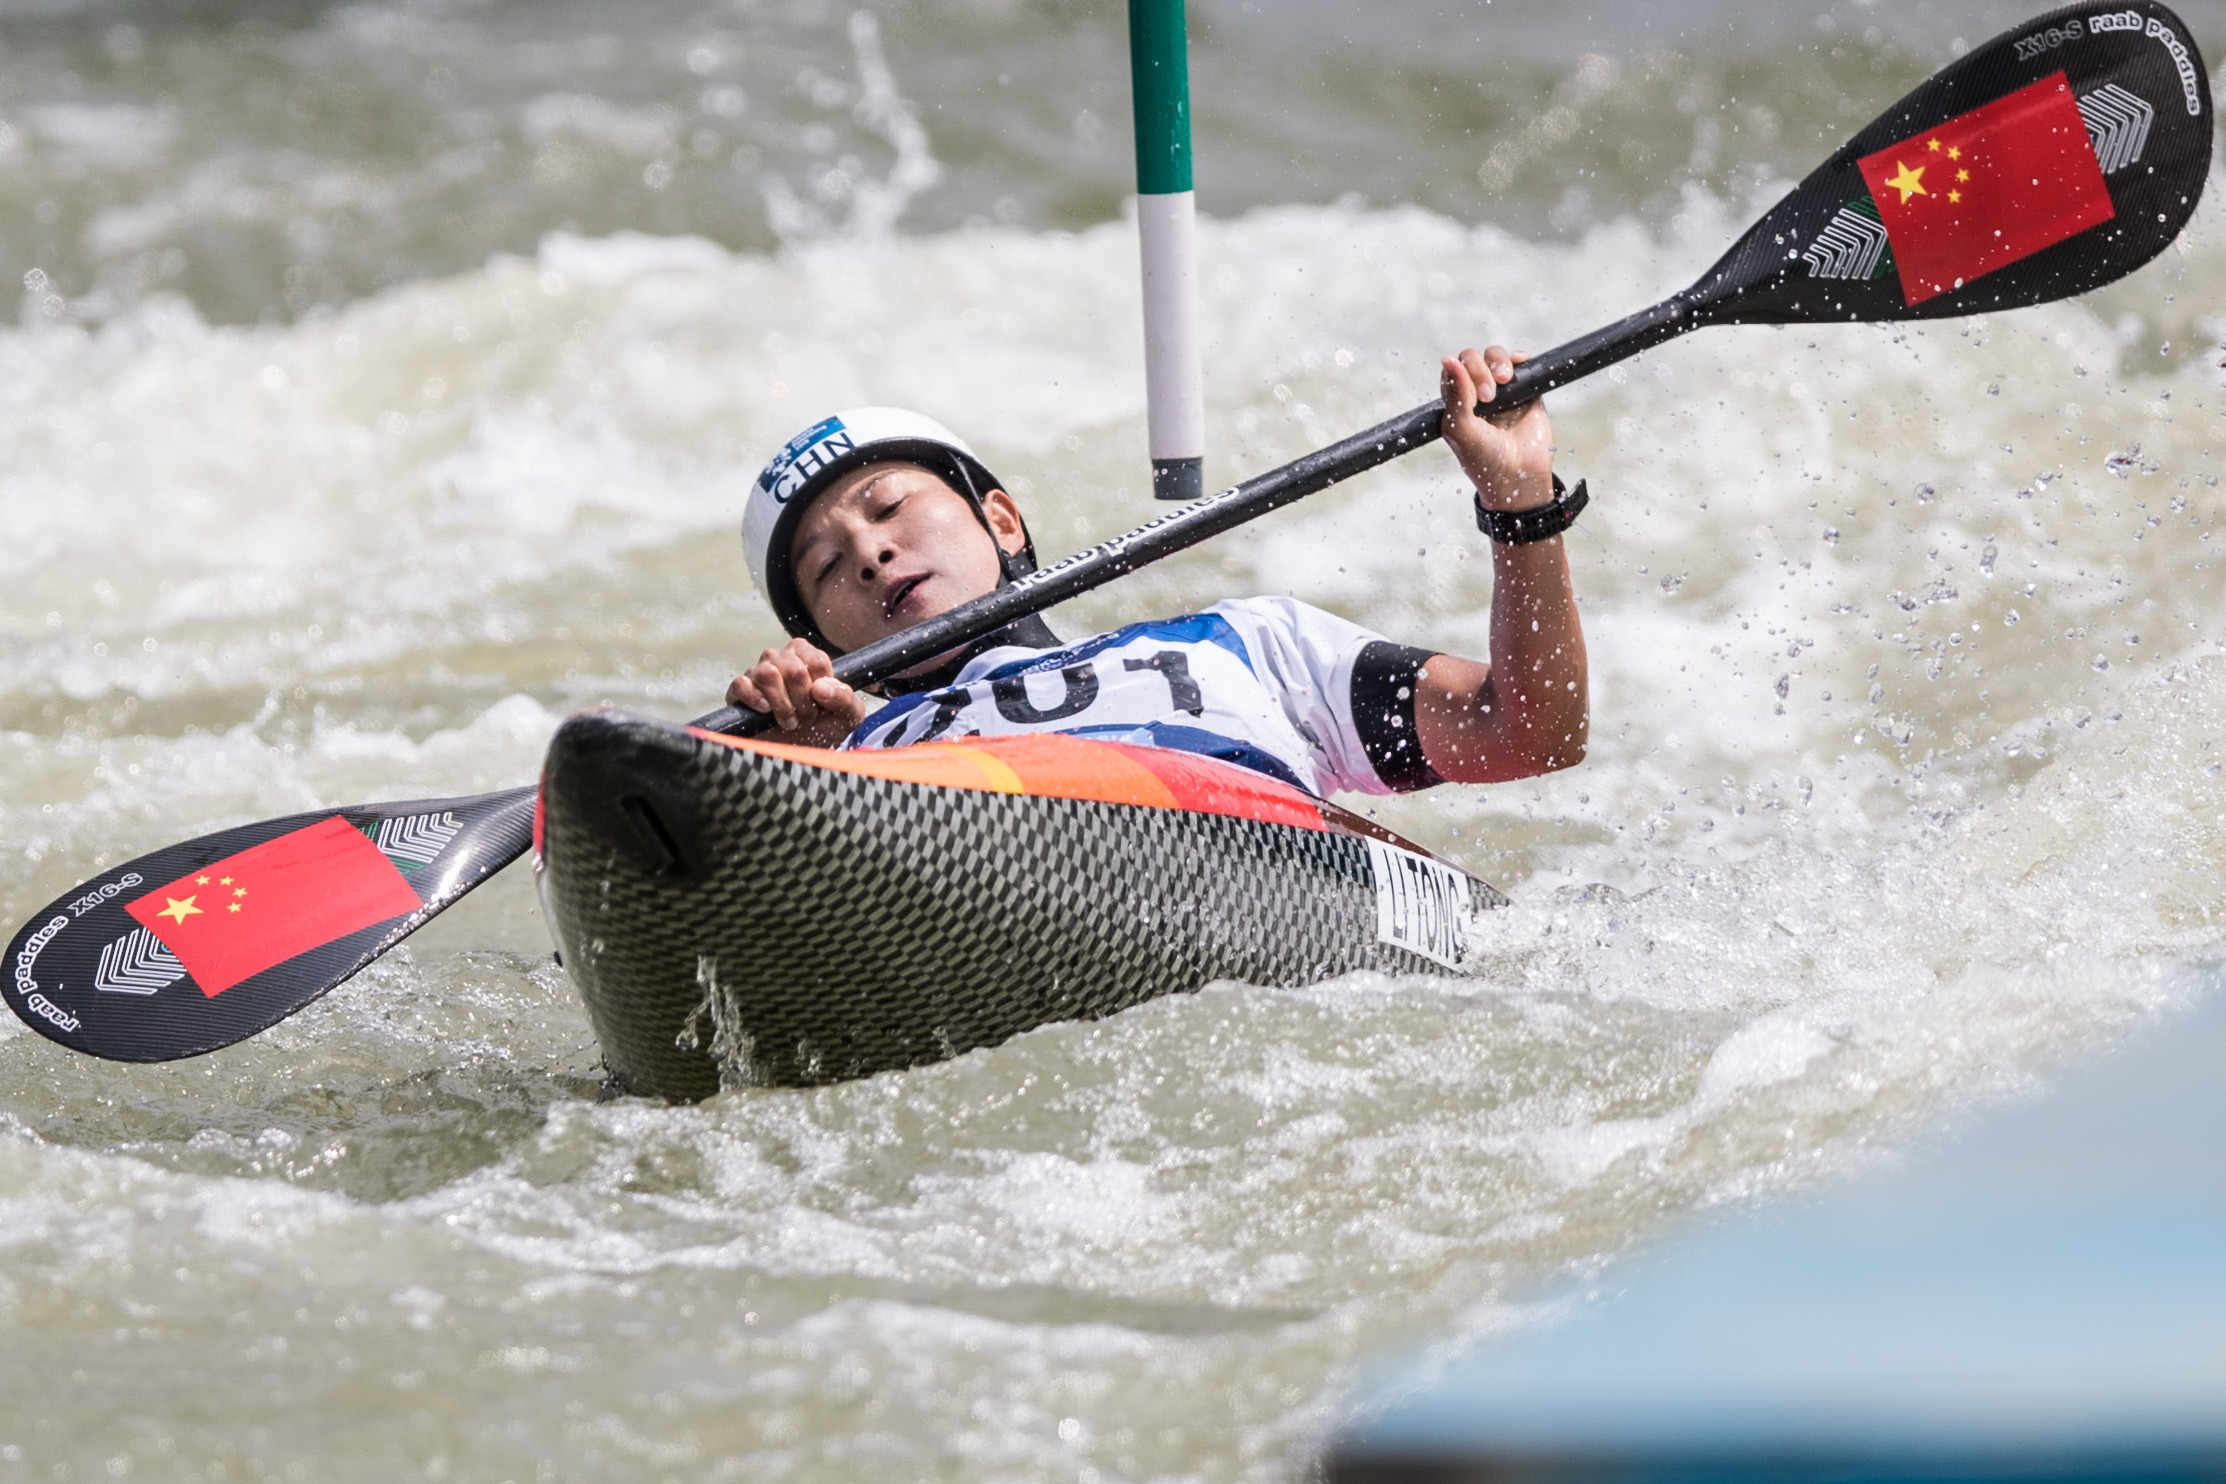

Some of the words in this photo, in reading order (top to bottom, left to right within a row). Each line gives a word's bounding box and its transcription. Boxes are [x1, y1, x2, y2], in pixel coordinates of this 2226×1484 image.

[2014, 20, 2083, 61] X16-S
[2089, 11, 2143, 33] raab
[2145, 18, 2200, 116] paddles
[774, 432, 855, 503] CHN
[66, 873, 143, 917] X16-S
[15, 915, 69, 995] paddles
[28, 993, 80, 1032] raab
